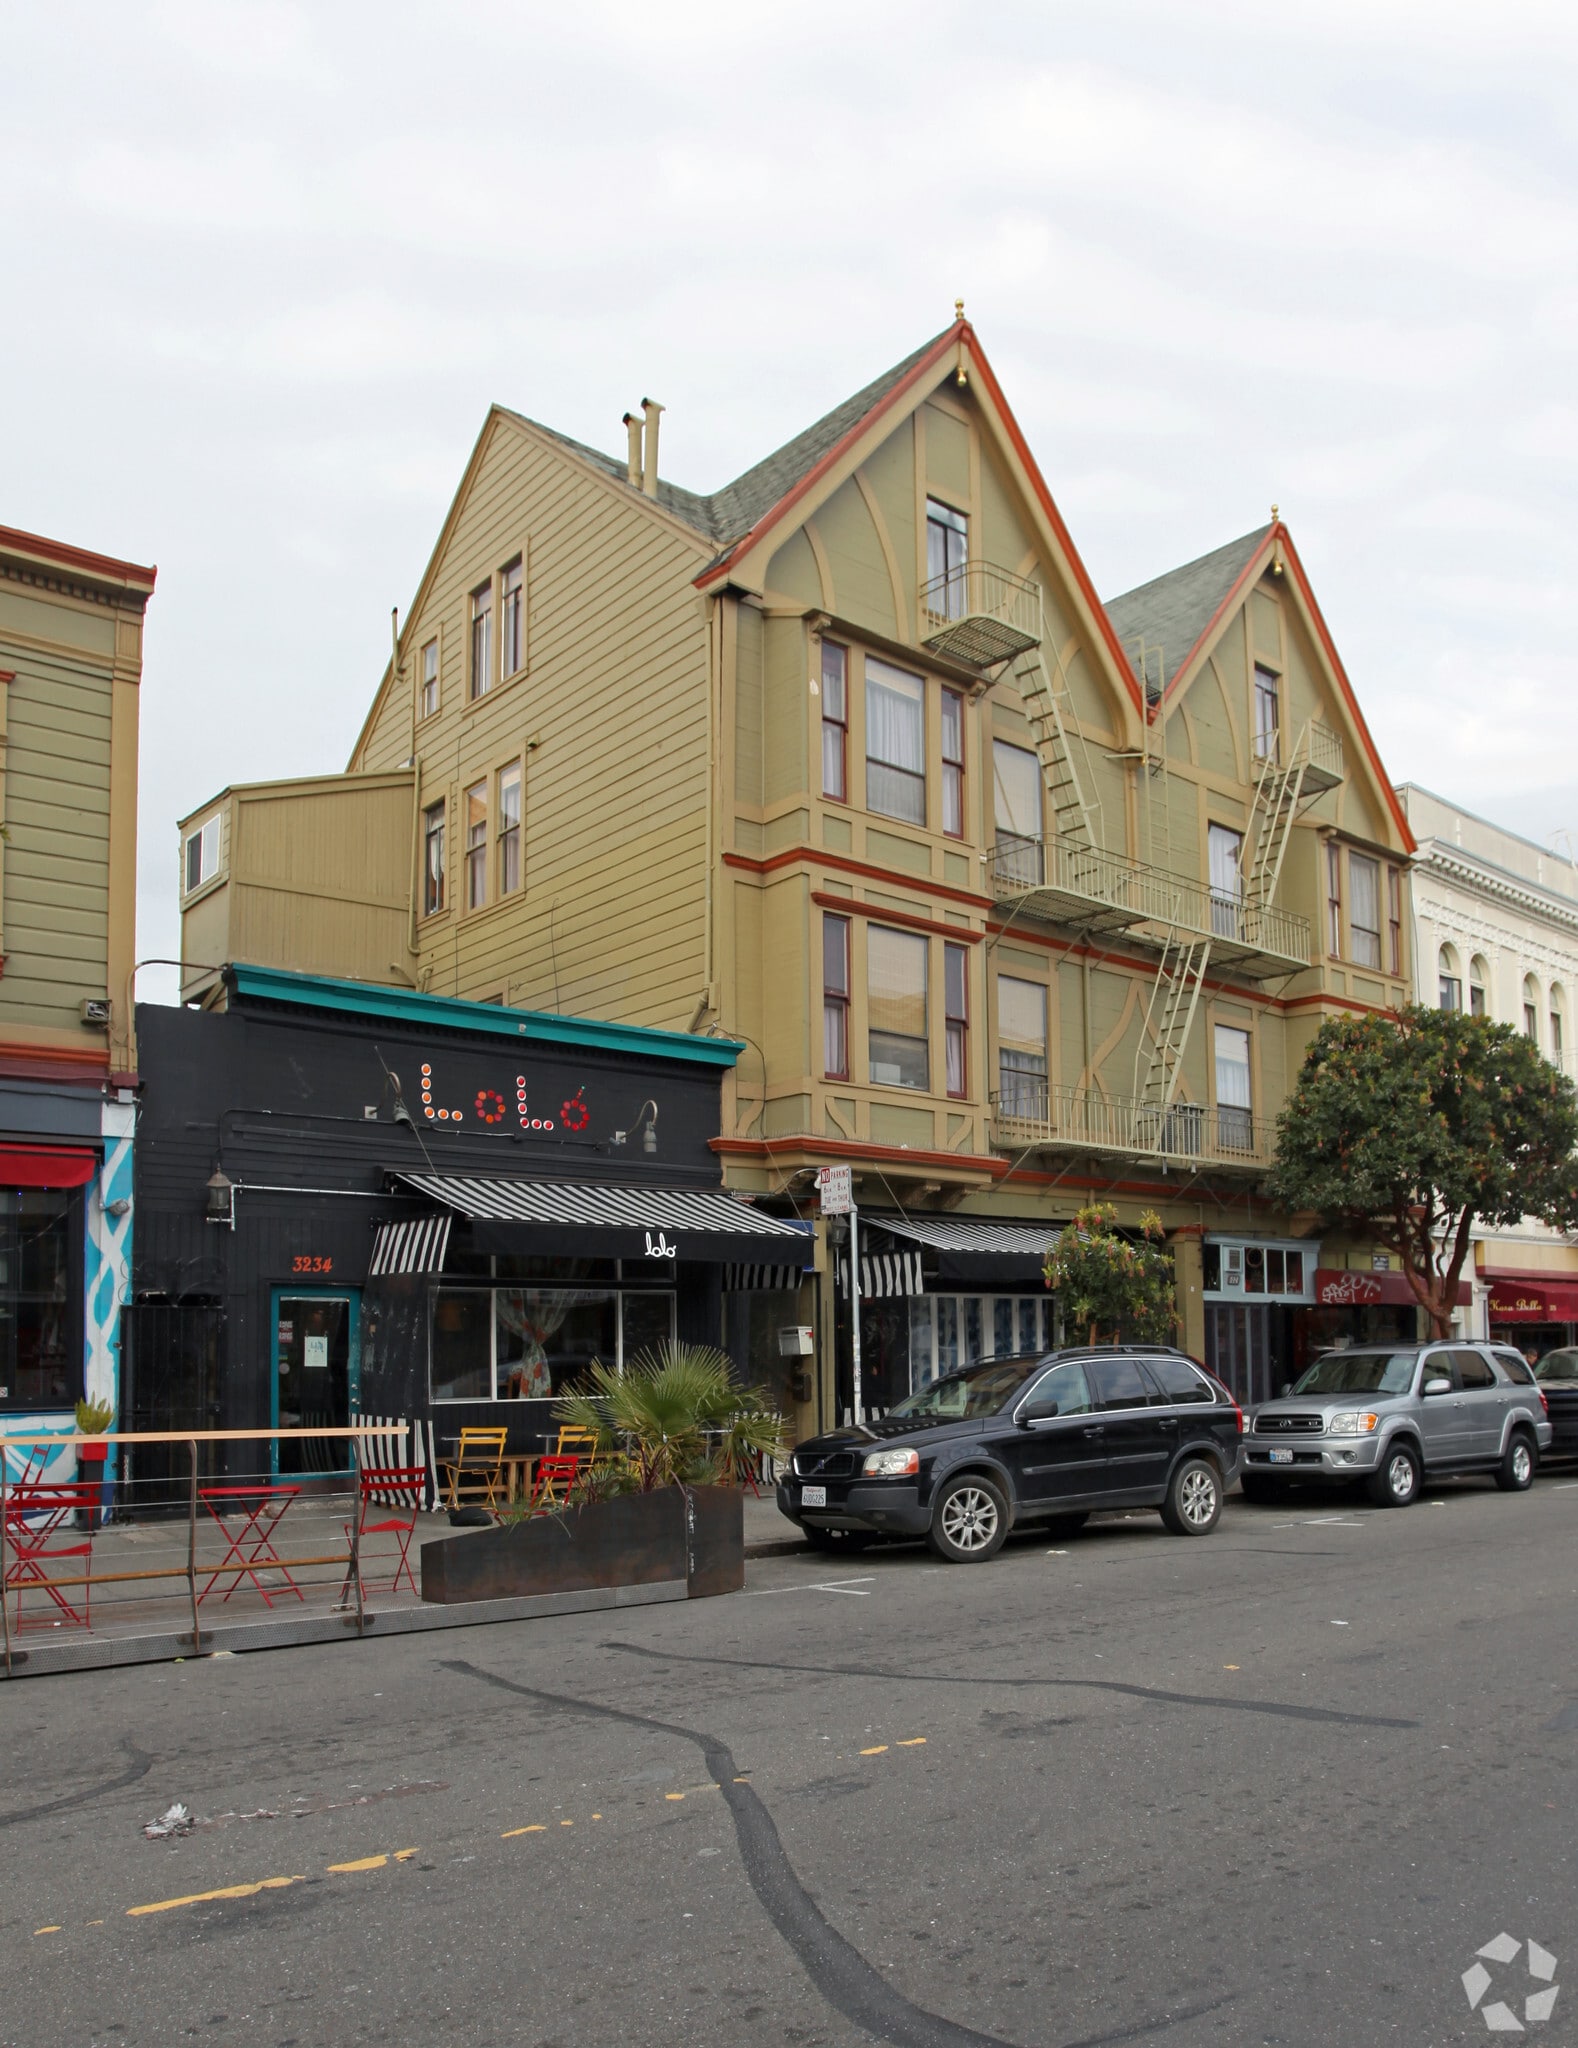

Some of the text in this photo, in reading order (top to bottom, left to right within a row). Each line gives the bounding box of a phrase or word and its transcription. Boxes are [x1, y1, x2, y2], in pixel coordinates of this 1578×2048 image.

[821, 1169, 849, 1183] NO PARKING
[292, 1256, 333, 1273] 3234
[1515, 1298, 1543, 1312] Bella
